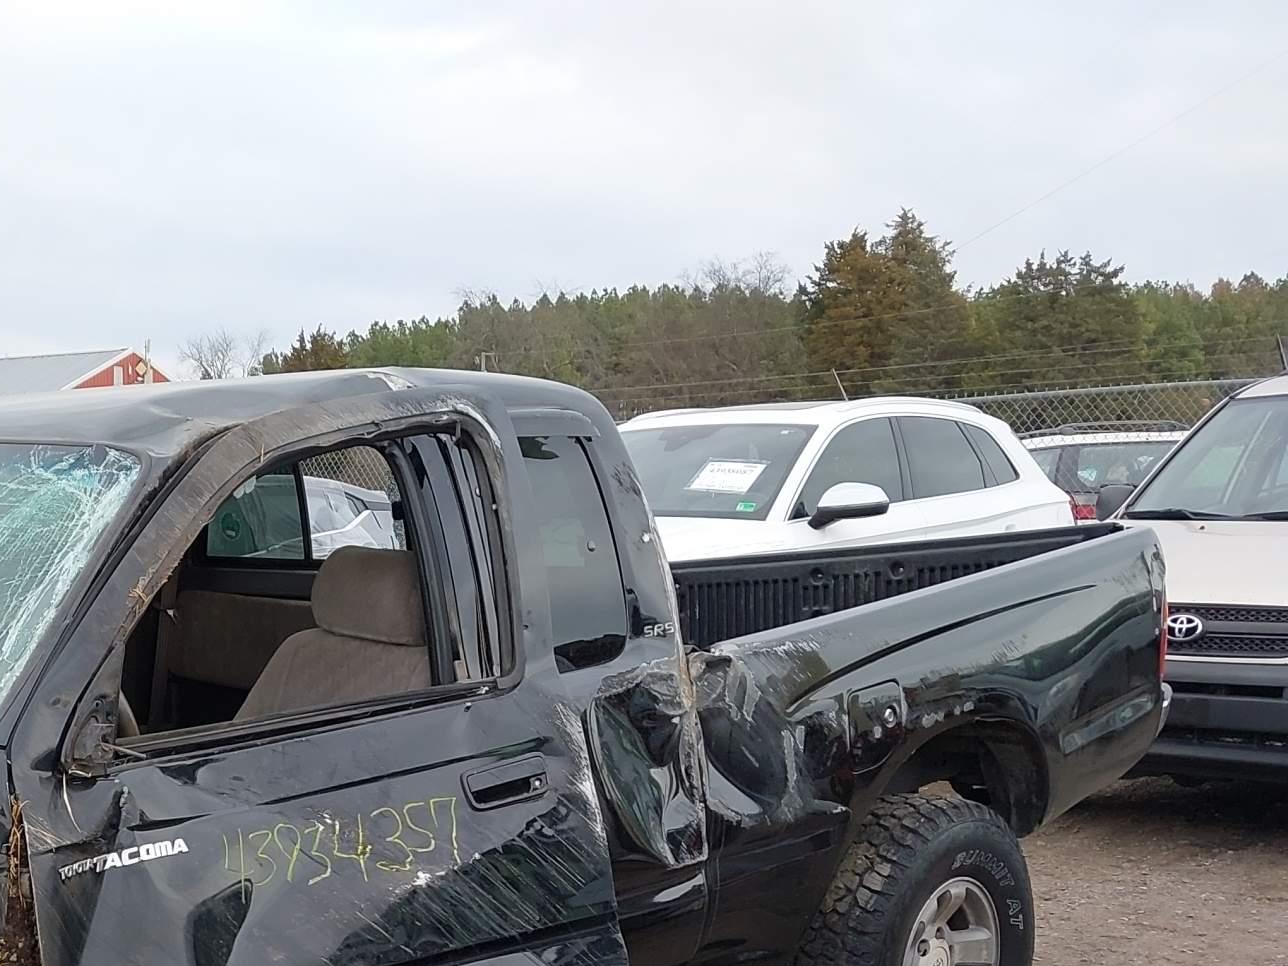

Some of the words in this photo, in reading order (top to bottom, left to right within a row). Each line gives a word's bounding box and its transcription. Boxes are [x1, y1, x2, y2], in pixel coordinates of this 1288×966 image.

[58, 858, 95, 880] TOYOTA
[94, 838, 189, 873] TACOMA
[223, 796, 461, 904] 43934357
[952, 849, 1015, 886] SUMMIT
[1006, 899, 1024, 930] AT
